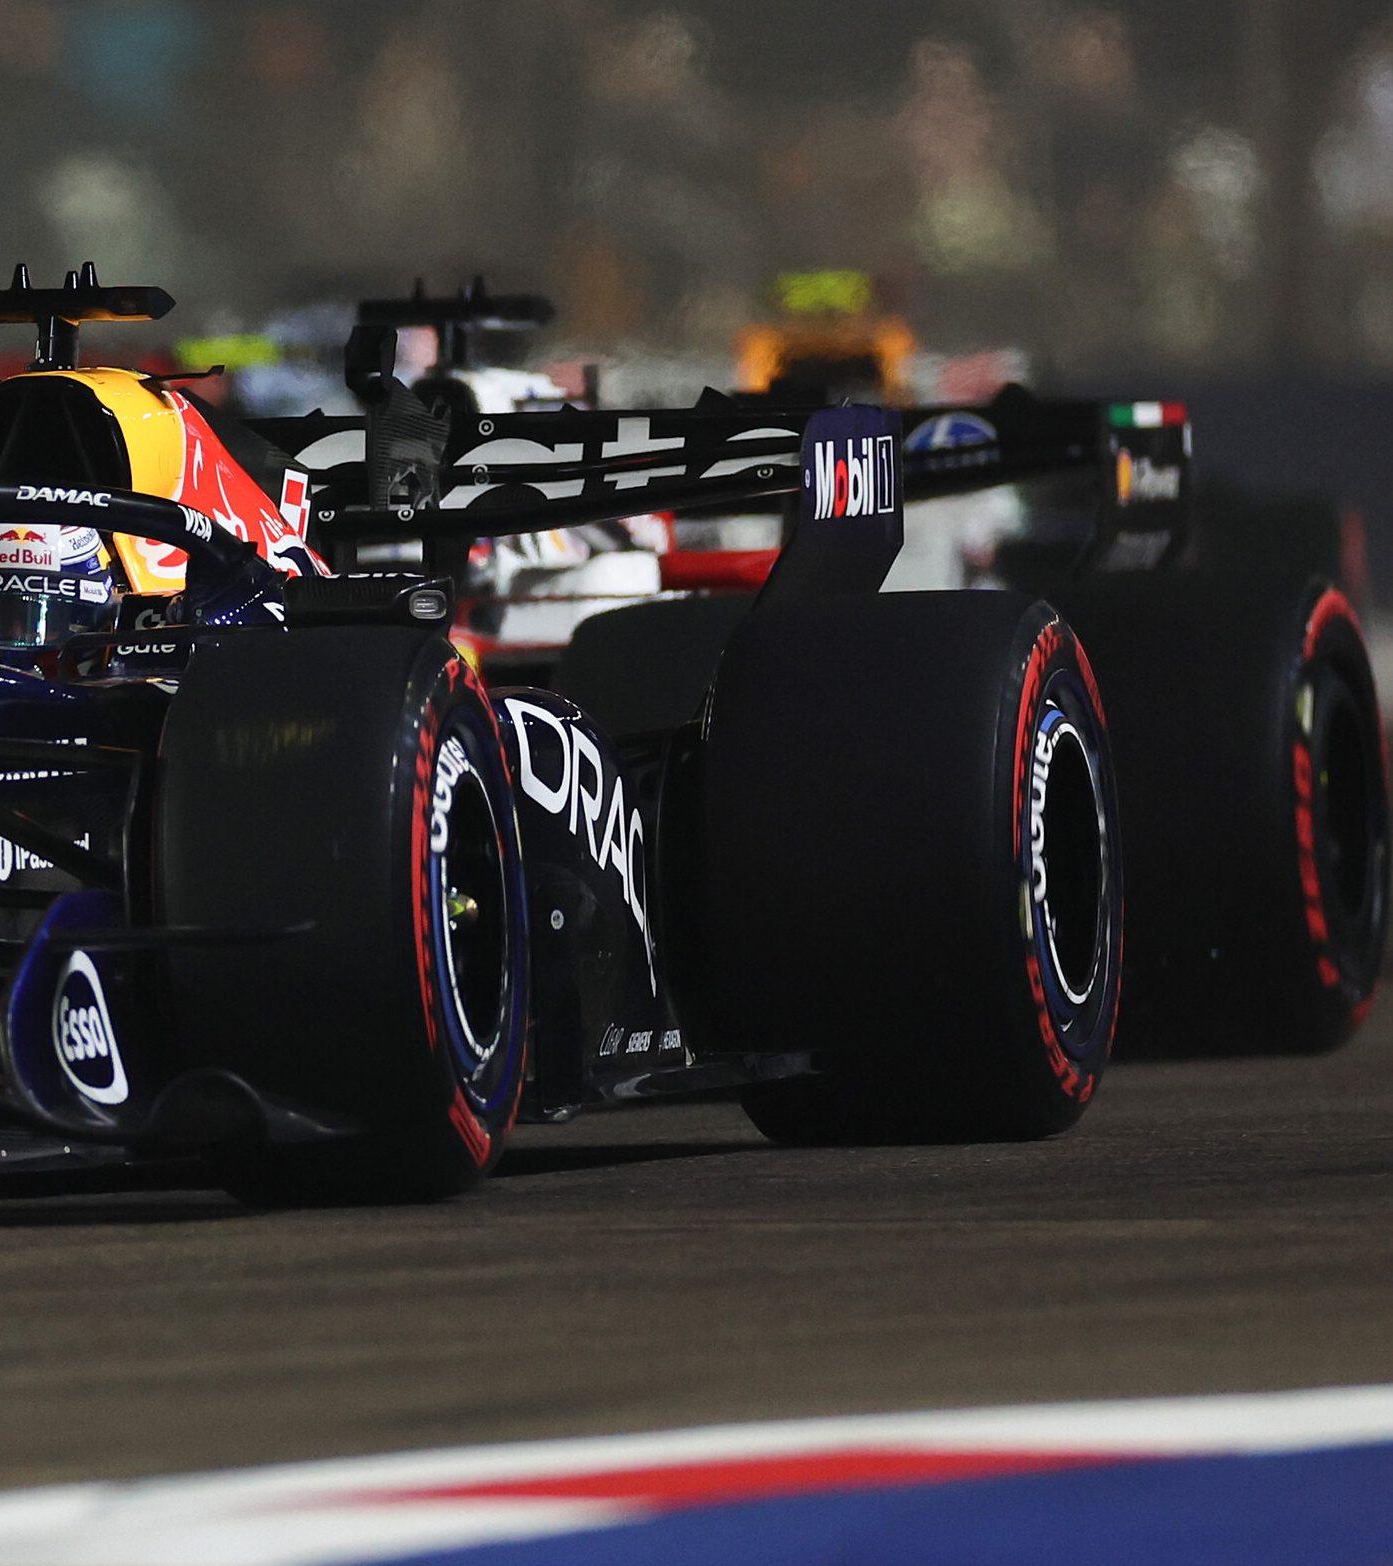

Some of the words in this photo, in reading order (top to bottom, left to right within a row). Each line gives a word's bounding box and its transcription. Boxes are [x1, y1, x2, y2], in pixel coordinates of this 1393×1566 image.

[15, 485, 112, 507] DAMAC
[814, 437, 874, 520] Mobil
[177, 504, 214, 542] VISA
[22, 551, 52, 566] Bull
[59, 994, 109, 1062] Esso
